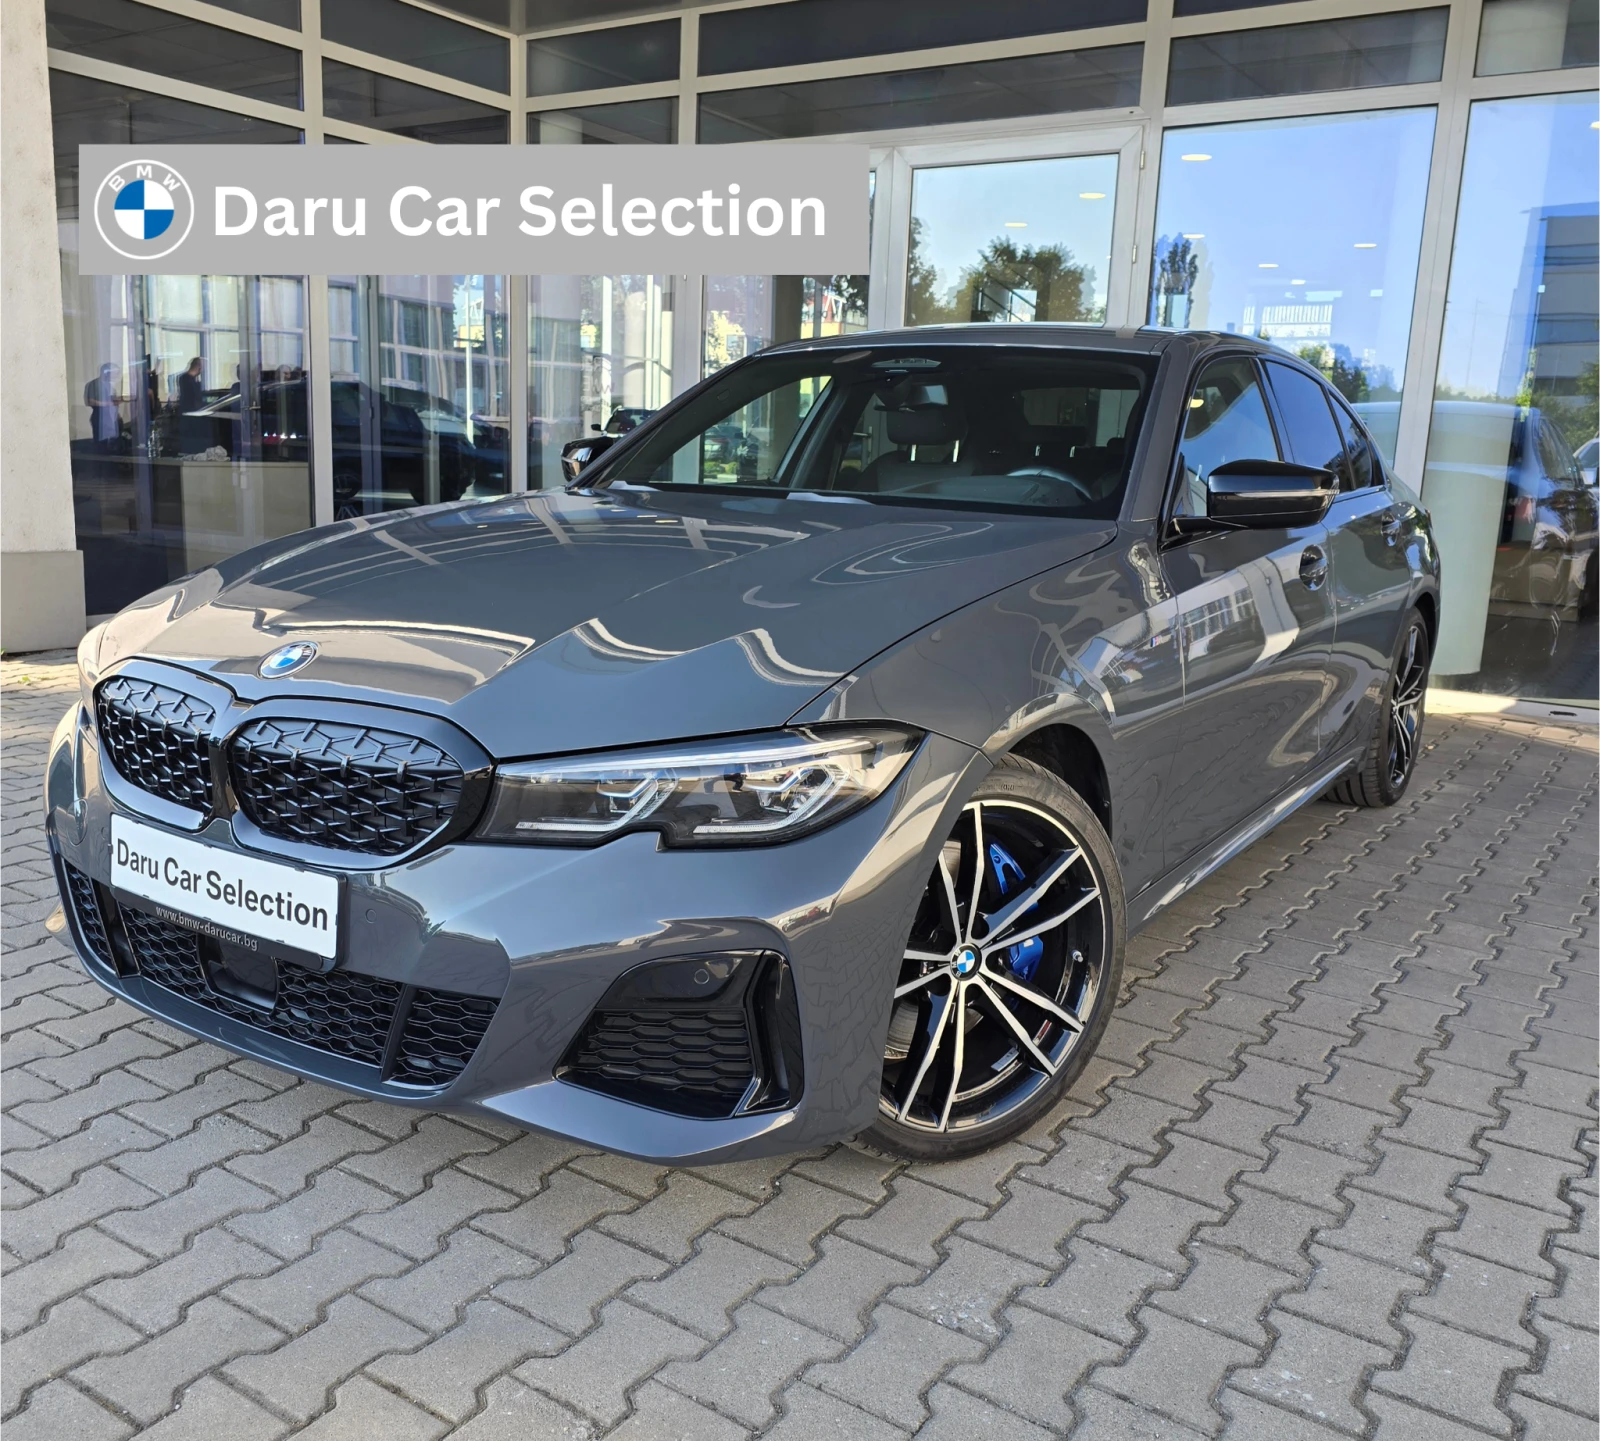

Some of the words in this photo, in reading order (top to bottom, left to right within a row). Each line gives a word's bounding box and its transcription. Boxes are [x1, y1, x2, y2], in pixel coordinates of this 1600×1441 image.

[117, 838, 159, 880] Daru
[164, 857, 202, 894] Car
[206, 870, 328, 931] Selection
[155, 906, 258, 951] www.bmw-darucar.bg
